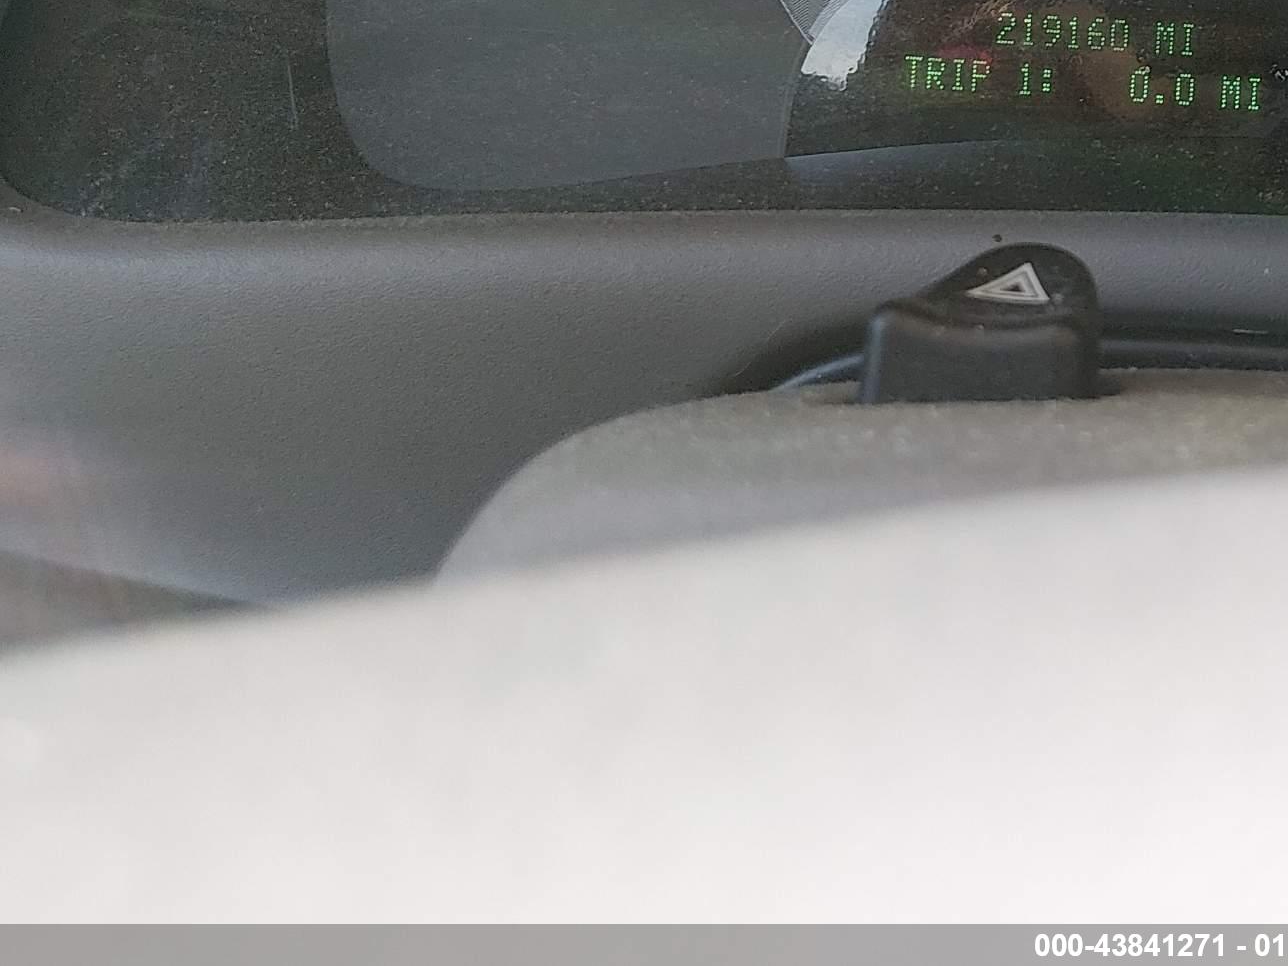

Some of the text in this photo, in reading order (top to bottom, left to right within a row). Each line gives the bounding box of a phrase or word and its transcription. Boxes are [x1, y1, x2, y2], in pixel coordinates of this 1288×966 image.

[996, 12, 1194, 57] 219160 MI
[905, 55, 1262, 111] TRIP 1: 0.0 MI
